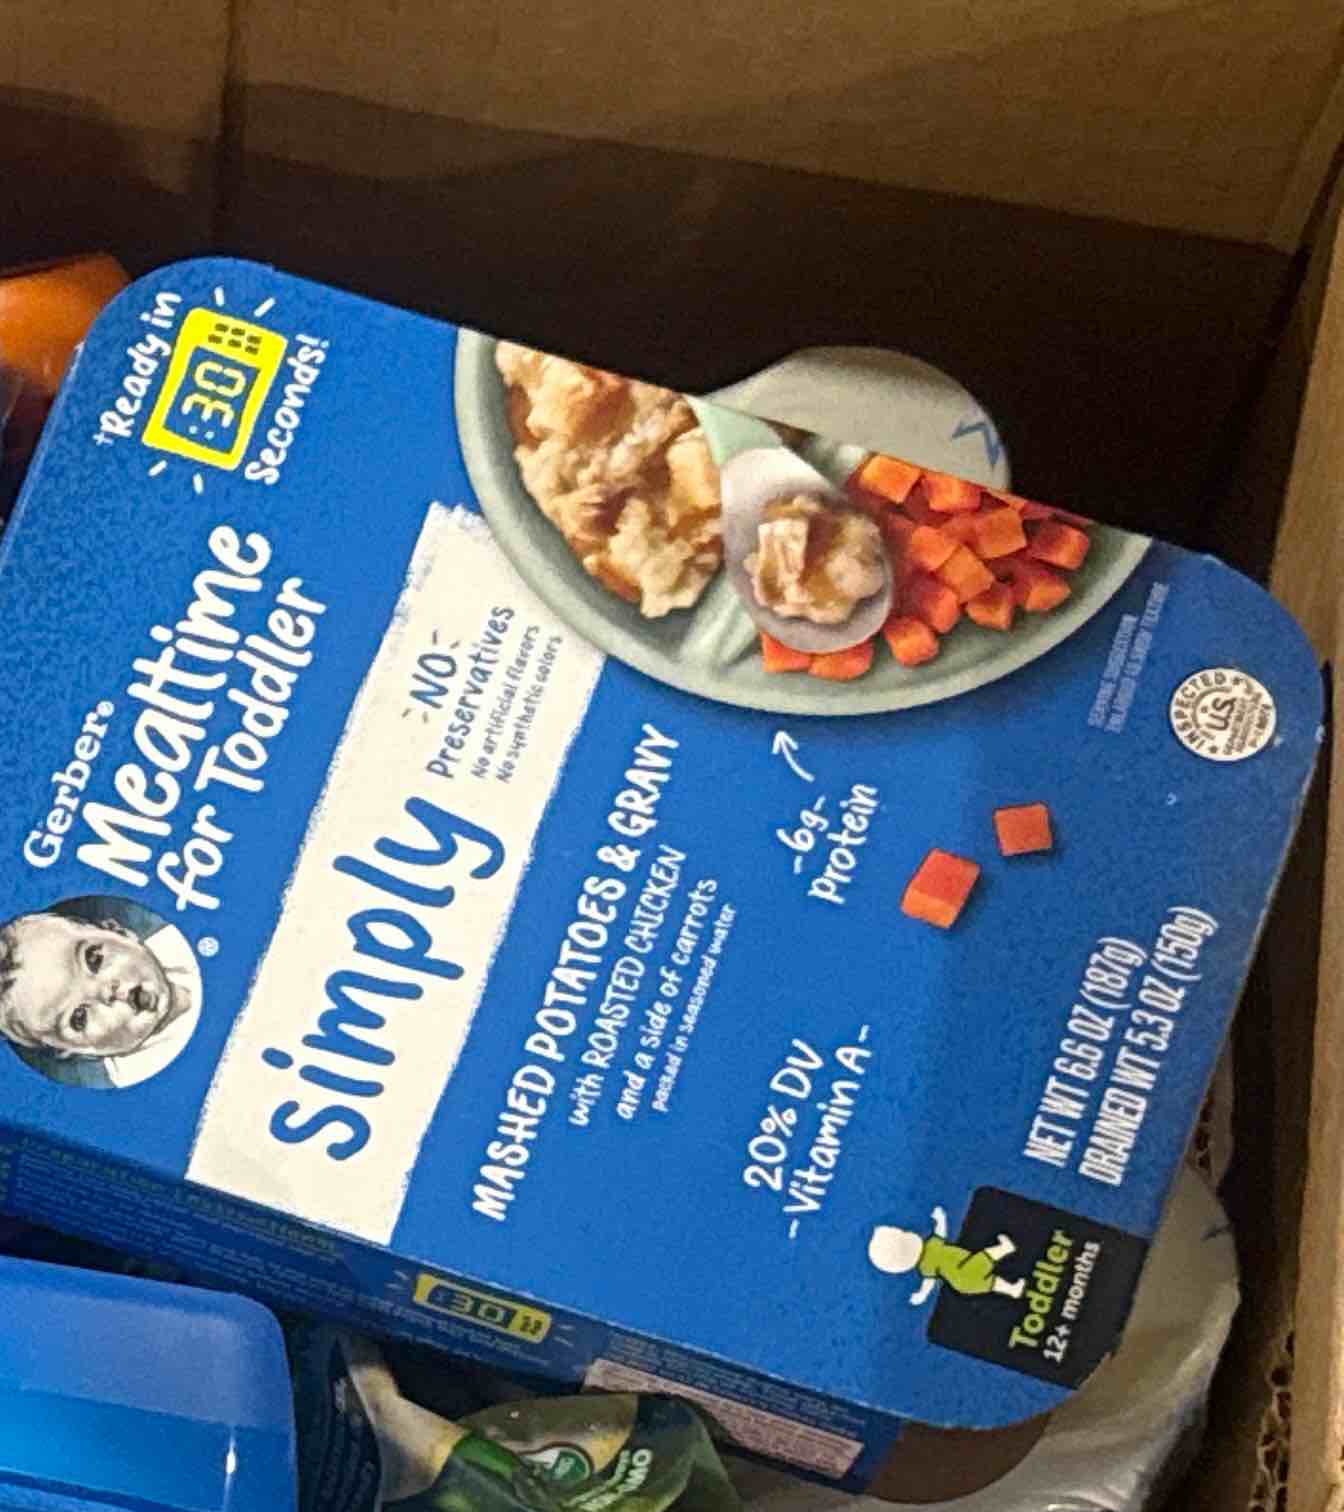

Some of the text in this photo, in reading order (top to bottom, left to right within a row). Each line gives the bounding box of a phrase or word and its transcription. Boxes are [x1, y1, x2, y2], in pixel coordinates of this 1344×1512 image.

[144, 291, 182, 328] in
[244, 333, 326, 484] Seconds!
[76, 525, 272, 887] Mealtime
[156, 576, 326, 911] for Toddler
[425, 606, 515, 779] Preservatives
[470, 624, 540, 778] No artificial flavors
[495, 634, 563, 782] No synthetic colors
[807, 783, 878, 904] Protein
[261, 796, 506, 1161] simply
[472, 723, 679, 1220] MASHED POTATOES & GRAVY
[569, 844, 686, 1126] with ROASTED CHICKEN
[616, 878, 717, 1119] and a side of carrots
[651, 903, 736, 1112] packed in seasoned water
[1023, 936, 1148, 1167] NET WT 6.6 OZ (187g)
[1078, 905, 1218, 1185] DRAINED WT 5.3 OZ (150g)
[743, 1038, 824, 1190] 20% DV
[1008, 1229, 1073, 1347] Toddler
[1043, 1241, 1100, 1362] 12+ months
